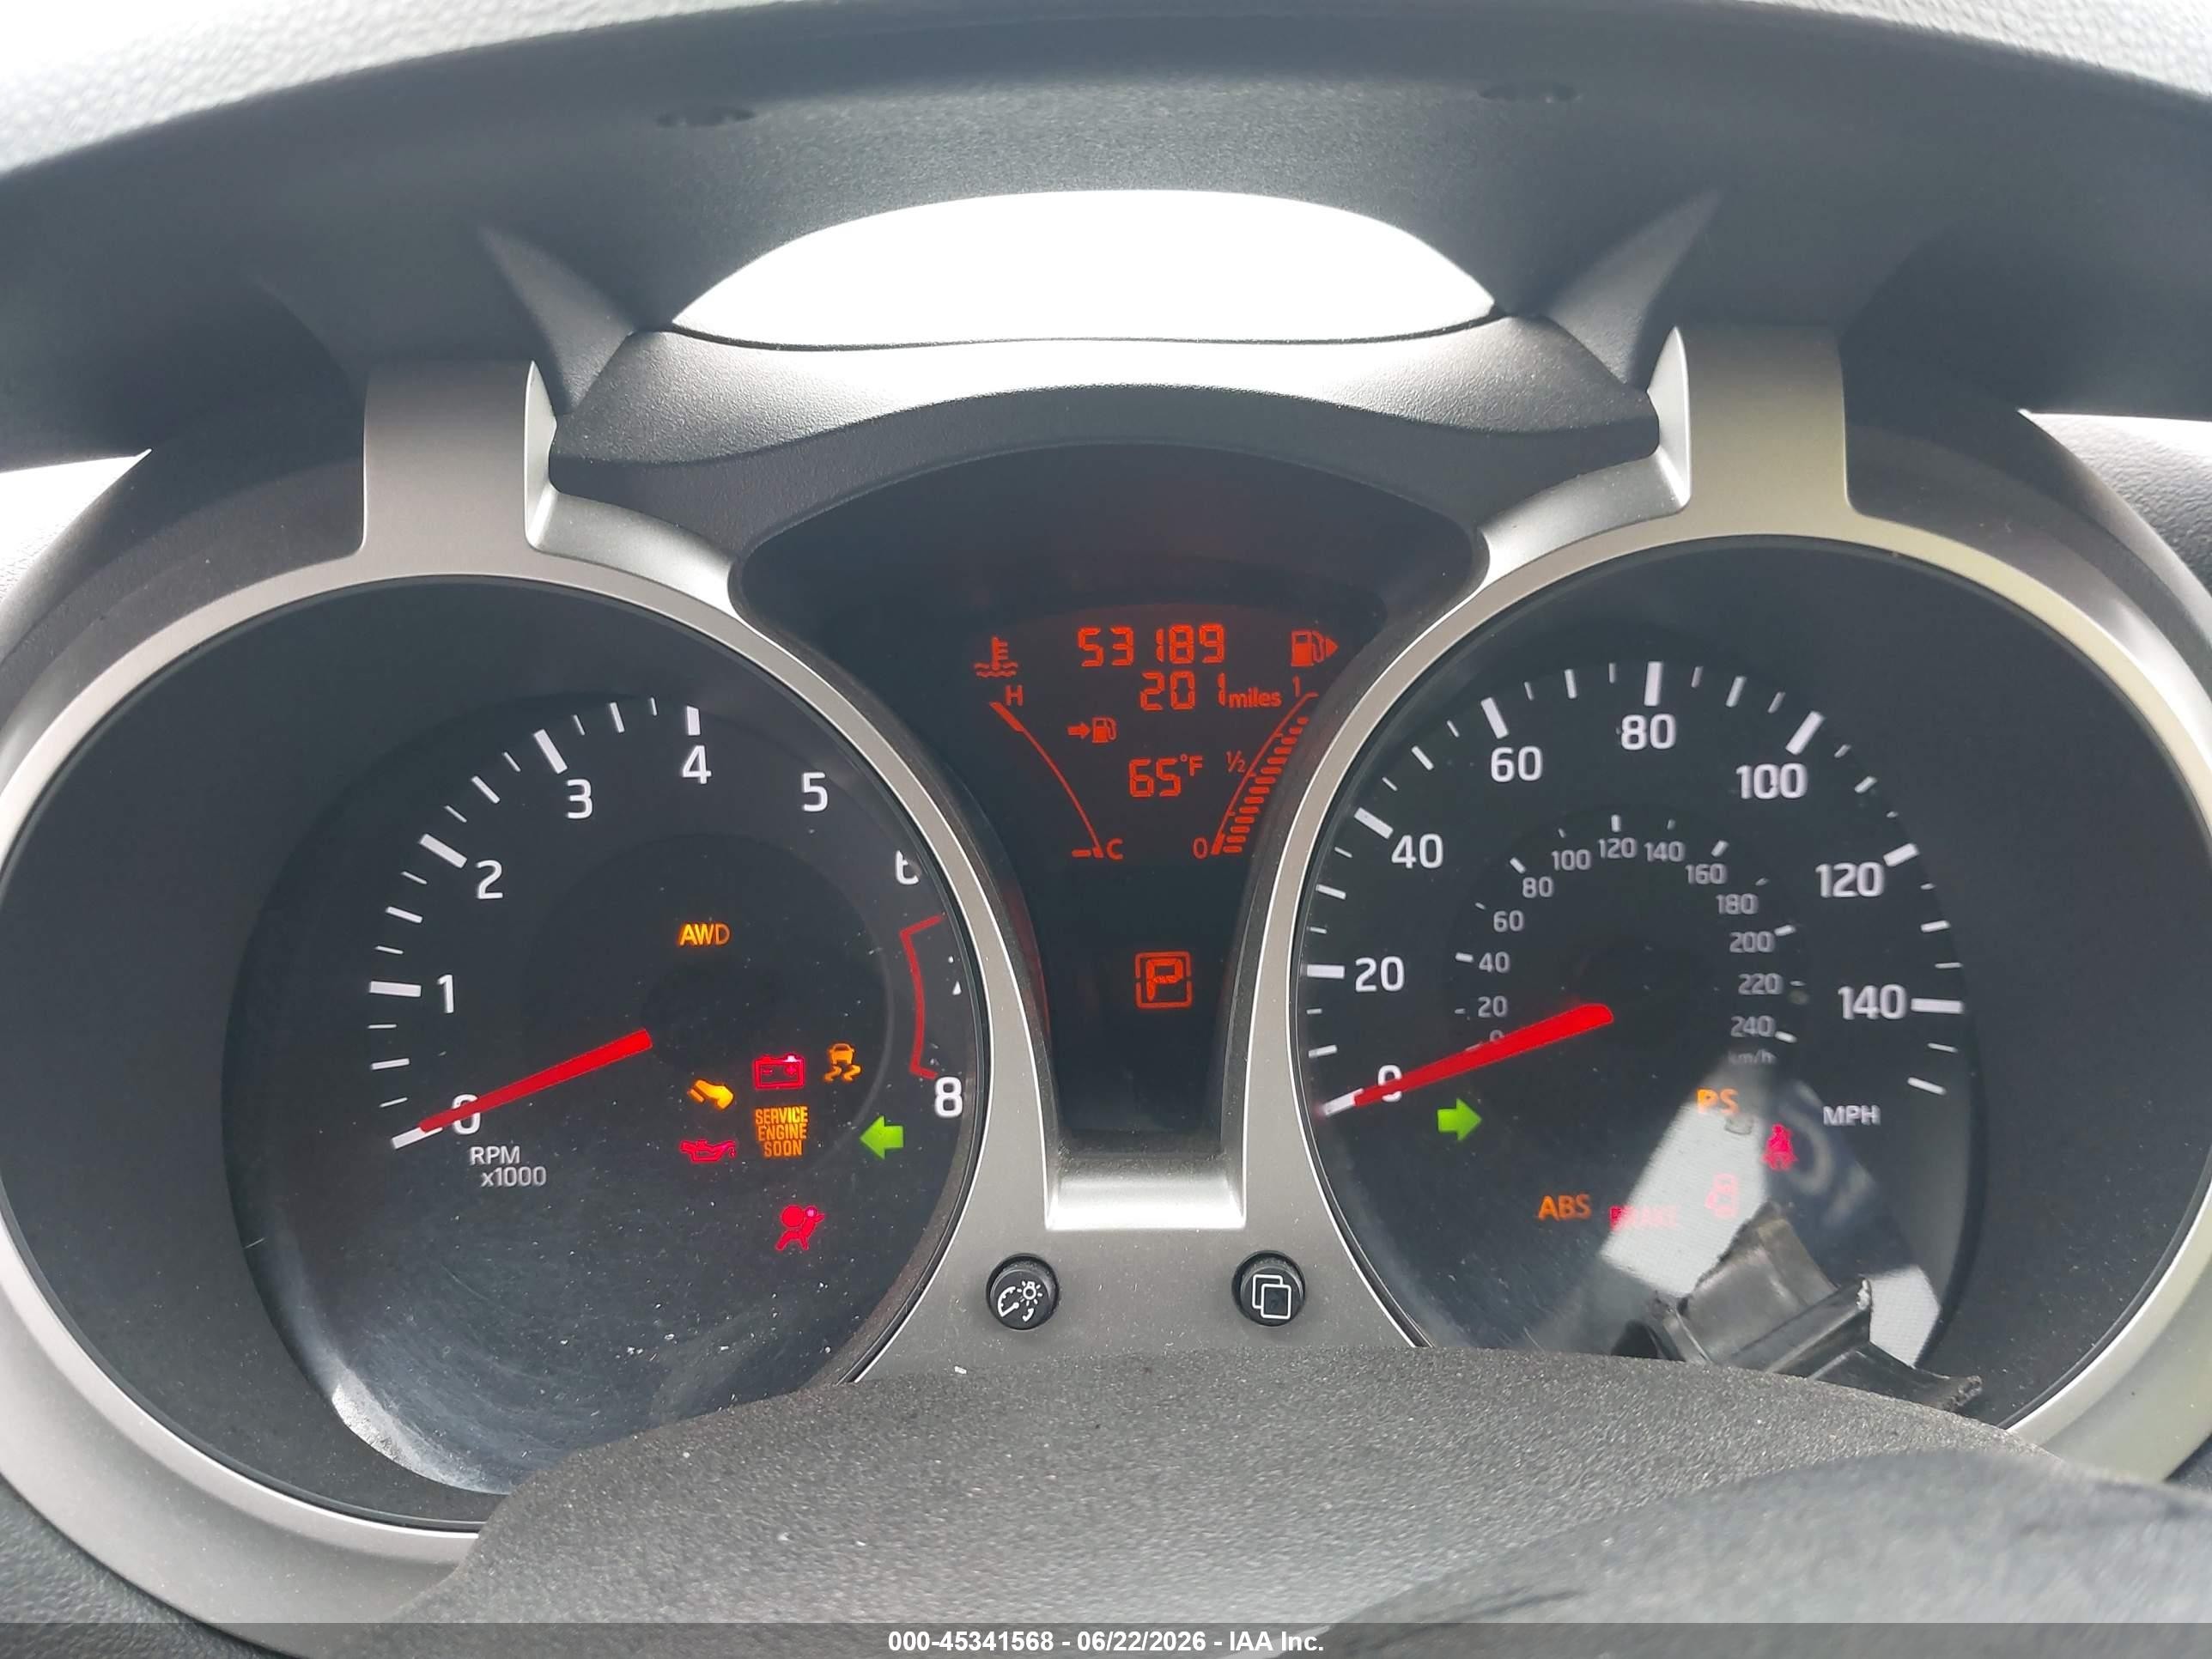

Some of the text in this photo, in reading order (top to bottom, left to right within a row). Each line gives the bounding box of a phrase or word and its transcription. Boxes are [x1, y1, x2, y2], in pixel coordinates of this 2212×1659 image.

[1078, 623, 1225, 666] 53189
[1006, 687, 1023, 704] H
[1140, 671, 1281, 711] 201 miles
[1621, 714, 1675, 750] 80
[683, 745, 711, 784] 4
[1492, 746, 1542, 781] 60
[802, 772, 828, 811] 5
[1736, 763, 1806, 799] 100
[567, 779, 592, 818] 3
[1105, 838, 1122, 860] C
[1390, 835, 1443, 868] 40
[1599, 837, 1637, 858] 120
[1644, 842, 1684, 861] 140
[1552, 849, 1590, 870] 100
[477, 860, 502, 899] 2
[1686, 864, 1726, 884] 160
[1816, 862, 1883, 898] 120
[1522, 877, 1553, 897] 80
[1717, 893, 1757, 915] 180
[1494, 910, 1523, 932] 60
[678, 923, 730, 945] AWD
[1730, 931, 1772, 952] 200
[1479, 952, 1510, 972] 40
[1146, 958, 1183, 1000] P
[1356, 957, 1404, 992] 20
[1738, 973, 1782, 994] 220
[438, 975, 453, 1013] 1
[1838, 984, 1905, 1019] 140
[1479, 996, 1507, 1018] 20
[1731, 1016, 1774, 1037] 240
[1378, 1065, 1401, 1102] 0
[935, 1077, 963, 1117] 8
[1696, 1088, 1740, 1115] PS
[452, 1094, 480, 1134] 0
[755, 1107, 808, 1124] SERVICE
[1823, 1105, 1879, 1125] MPH
[758, 1123, 806, 1140] ENGINE
[471, 1146, 520, 1164] RPM
[764, 1140, 803, 1157] SOON
[481, 1166, 546, 1187] x1000
[1539, 1194, 1589, 1219] ABS
